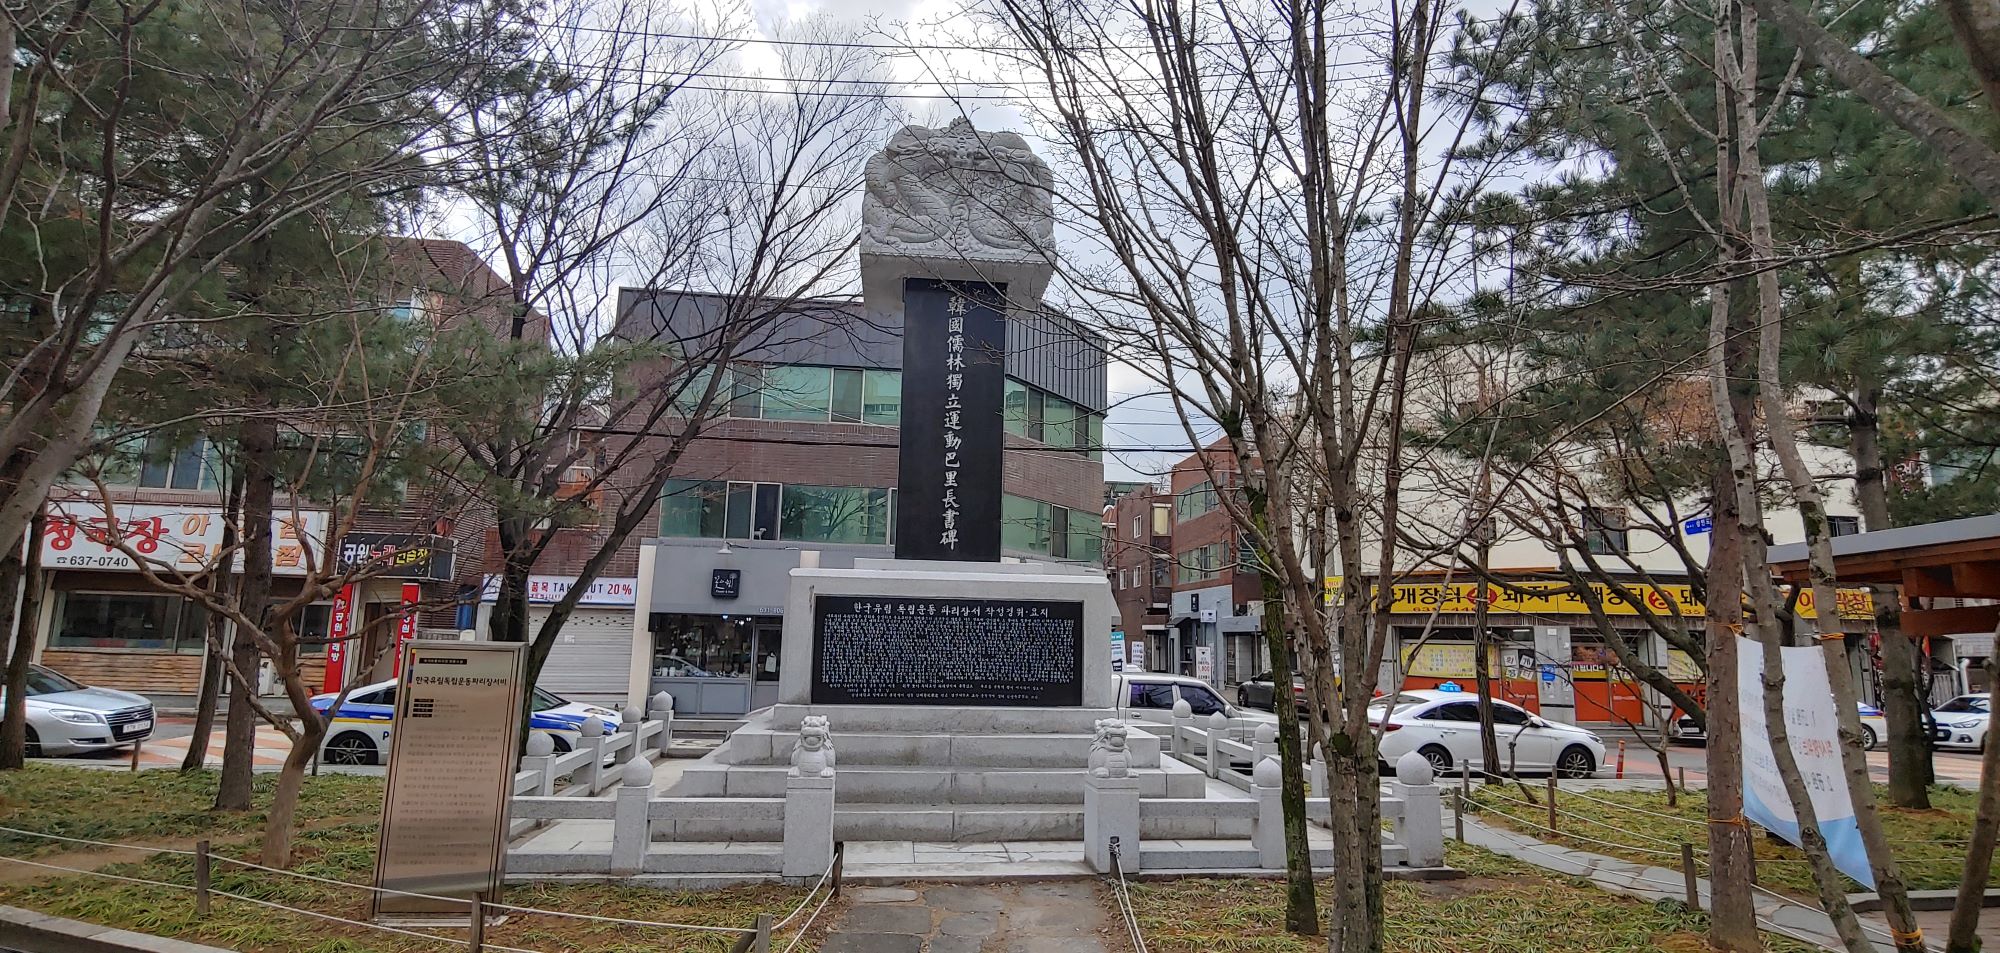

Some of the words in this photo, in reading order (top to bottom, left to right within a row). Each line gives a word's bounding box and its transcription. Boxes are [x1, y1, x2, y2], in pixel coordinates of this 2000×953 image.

[940, 296, 966, 550] 韓國儒林獨立運動巴里長書碑
[70, 556, 128, 567] 637-0740
[854, 602, 892, 614] 한국유림
[897, 603, 936, 615] 독립운동
[941, 605, 980, 617] 파리장서
[331, 613, 344, 662] 공원래방
